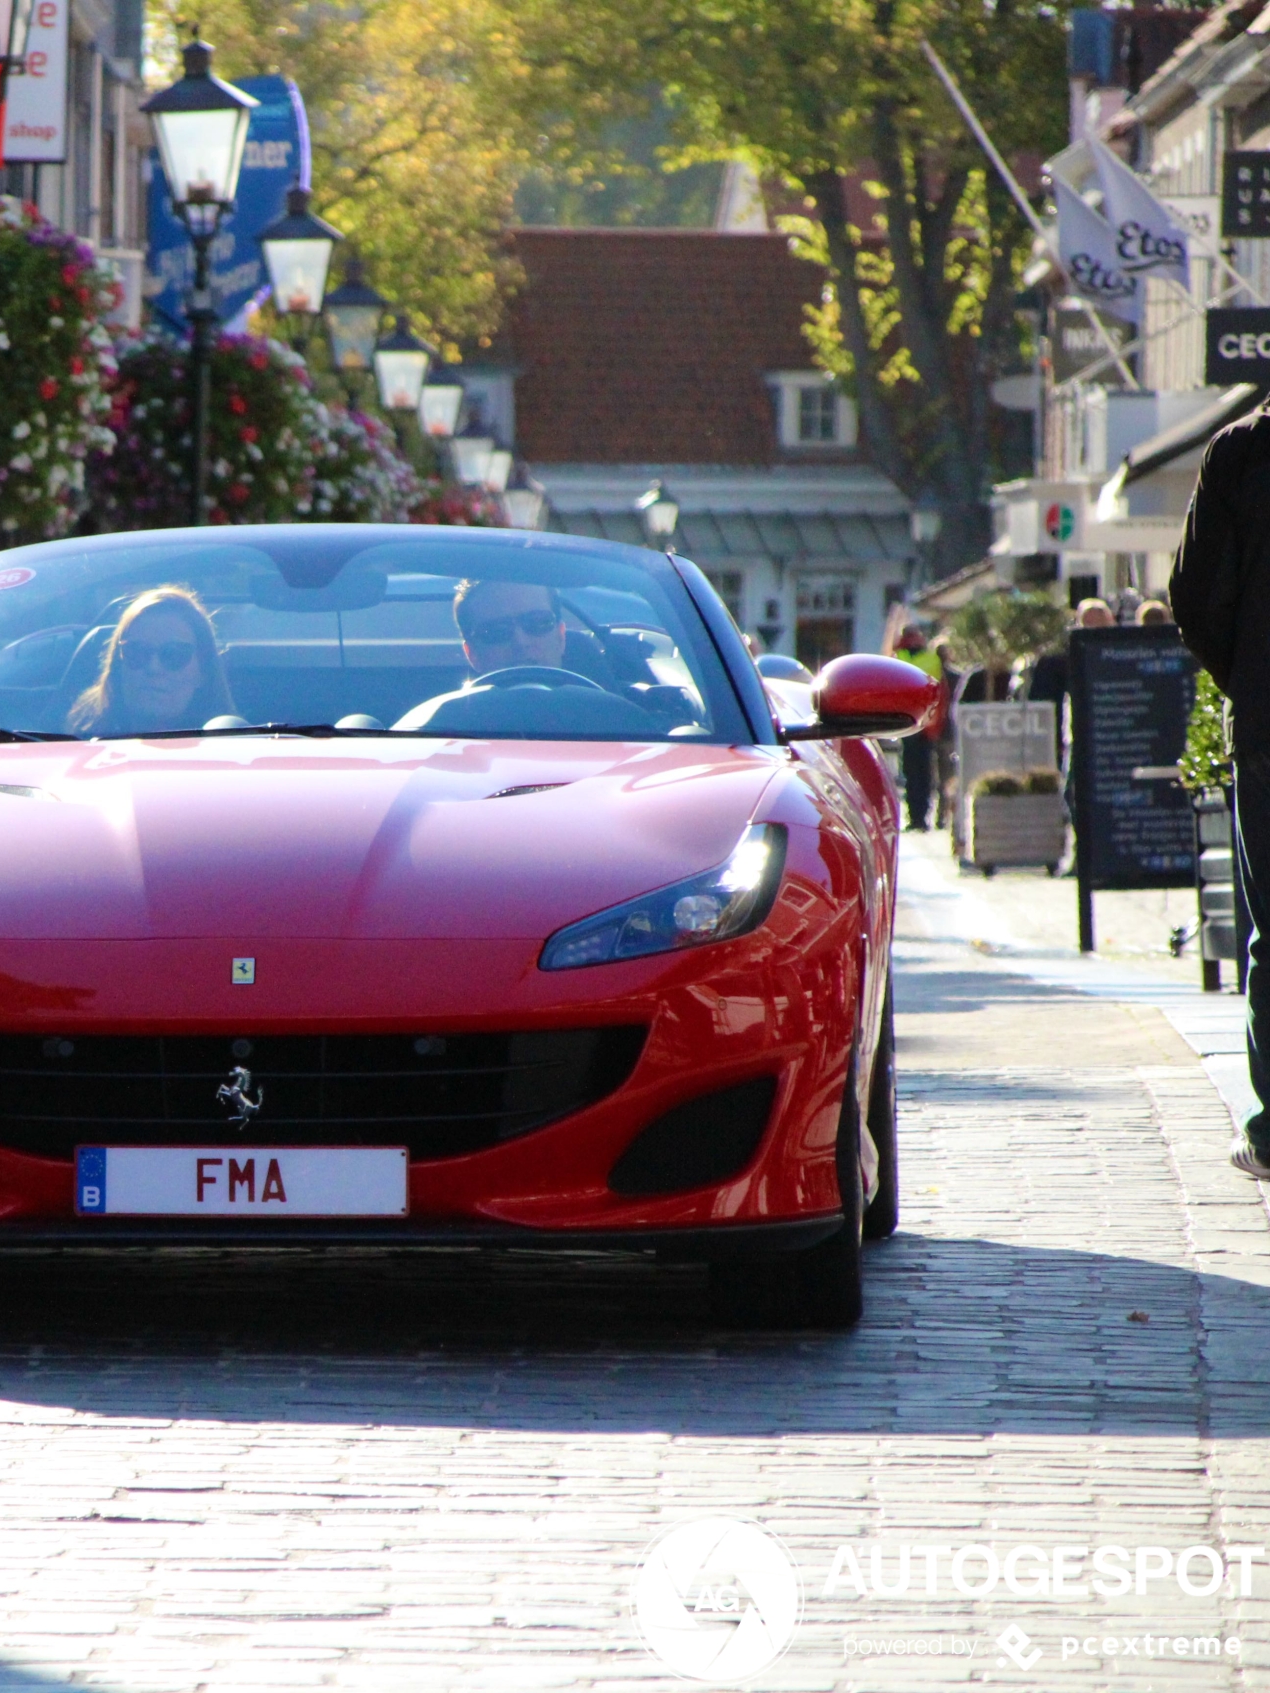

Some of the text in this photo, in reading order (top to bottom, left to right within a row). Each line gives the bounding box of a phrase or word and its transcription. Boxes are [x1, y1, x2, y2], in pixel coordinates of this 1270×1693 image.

[9, 121, 57, 141] shop
[965, 712, 1049, 737] CECIL
[82, 1158, 287, 1208] B FMA
